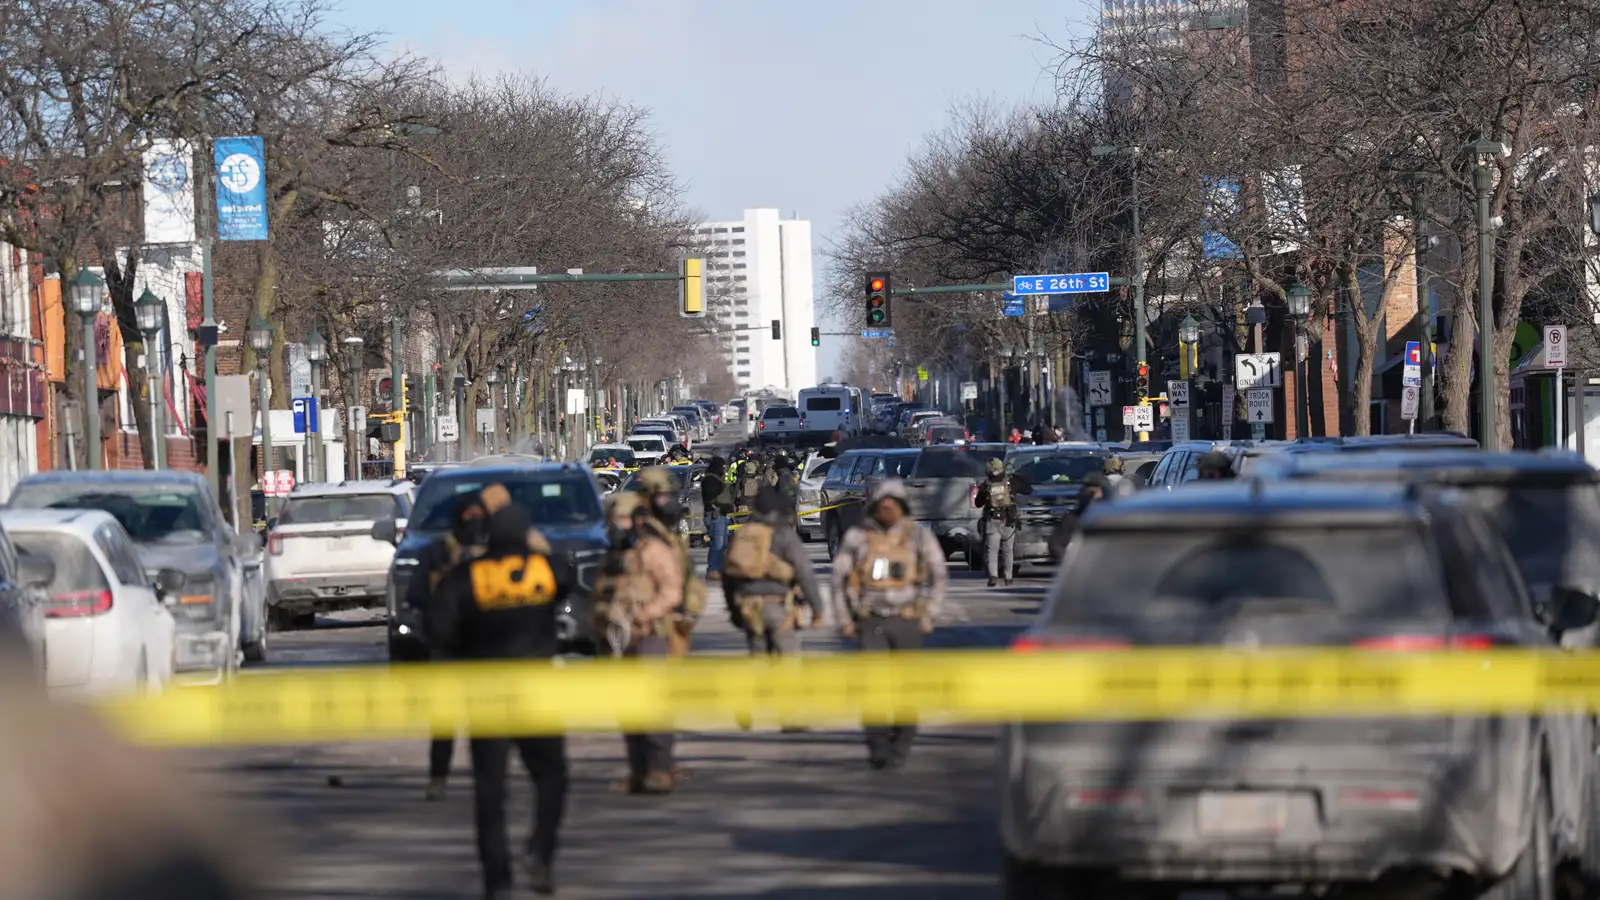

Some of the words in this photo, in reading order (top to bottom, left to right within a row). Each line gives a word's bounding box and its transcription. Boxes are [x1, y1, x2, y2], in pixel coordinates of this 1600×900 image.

[1035, 280, 1044, 291] E
[1050, 278, 1083, 290] 26th
[1089, 277, 1105, 288] St
[1249, 392, 1270, 400] TRUCK
